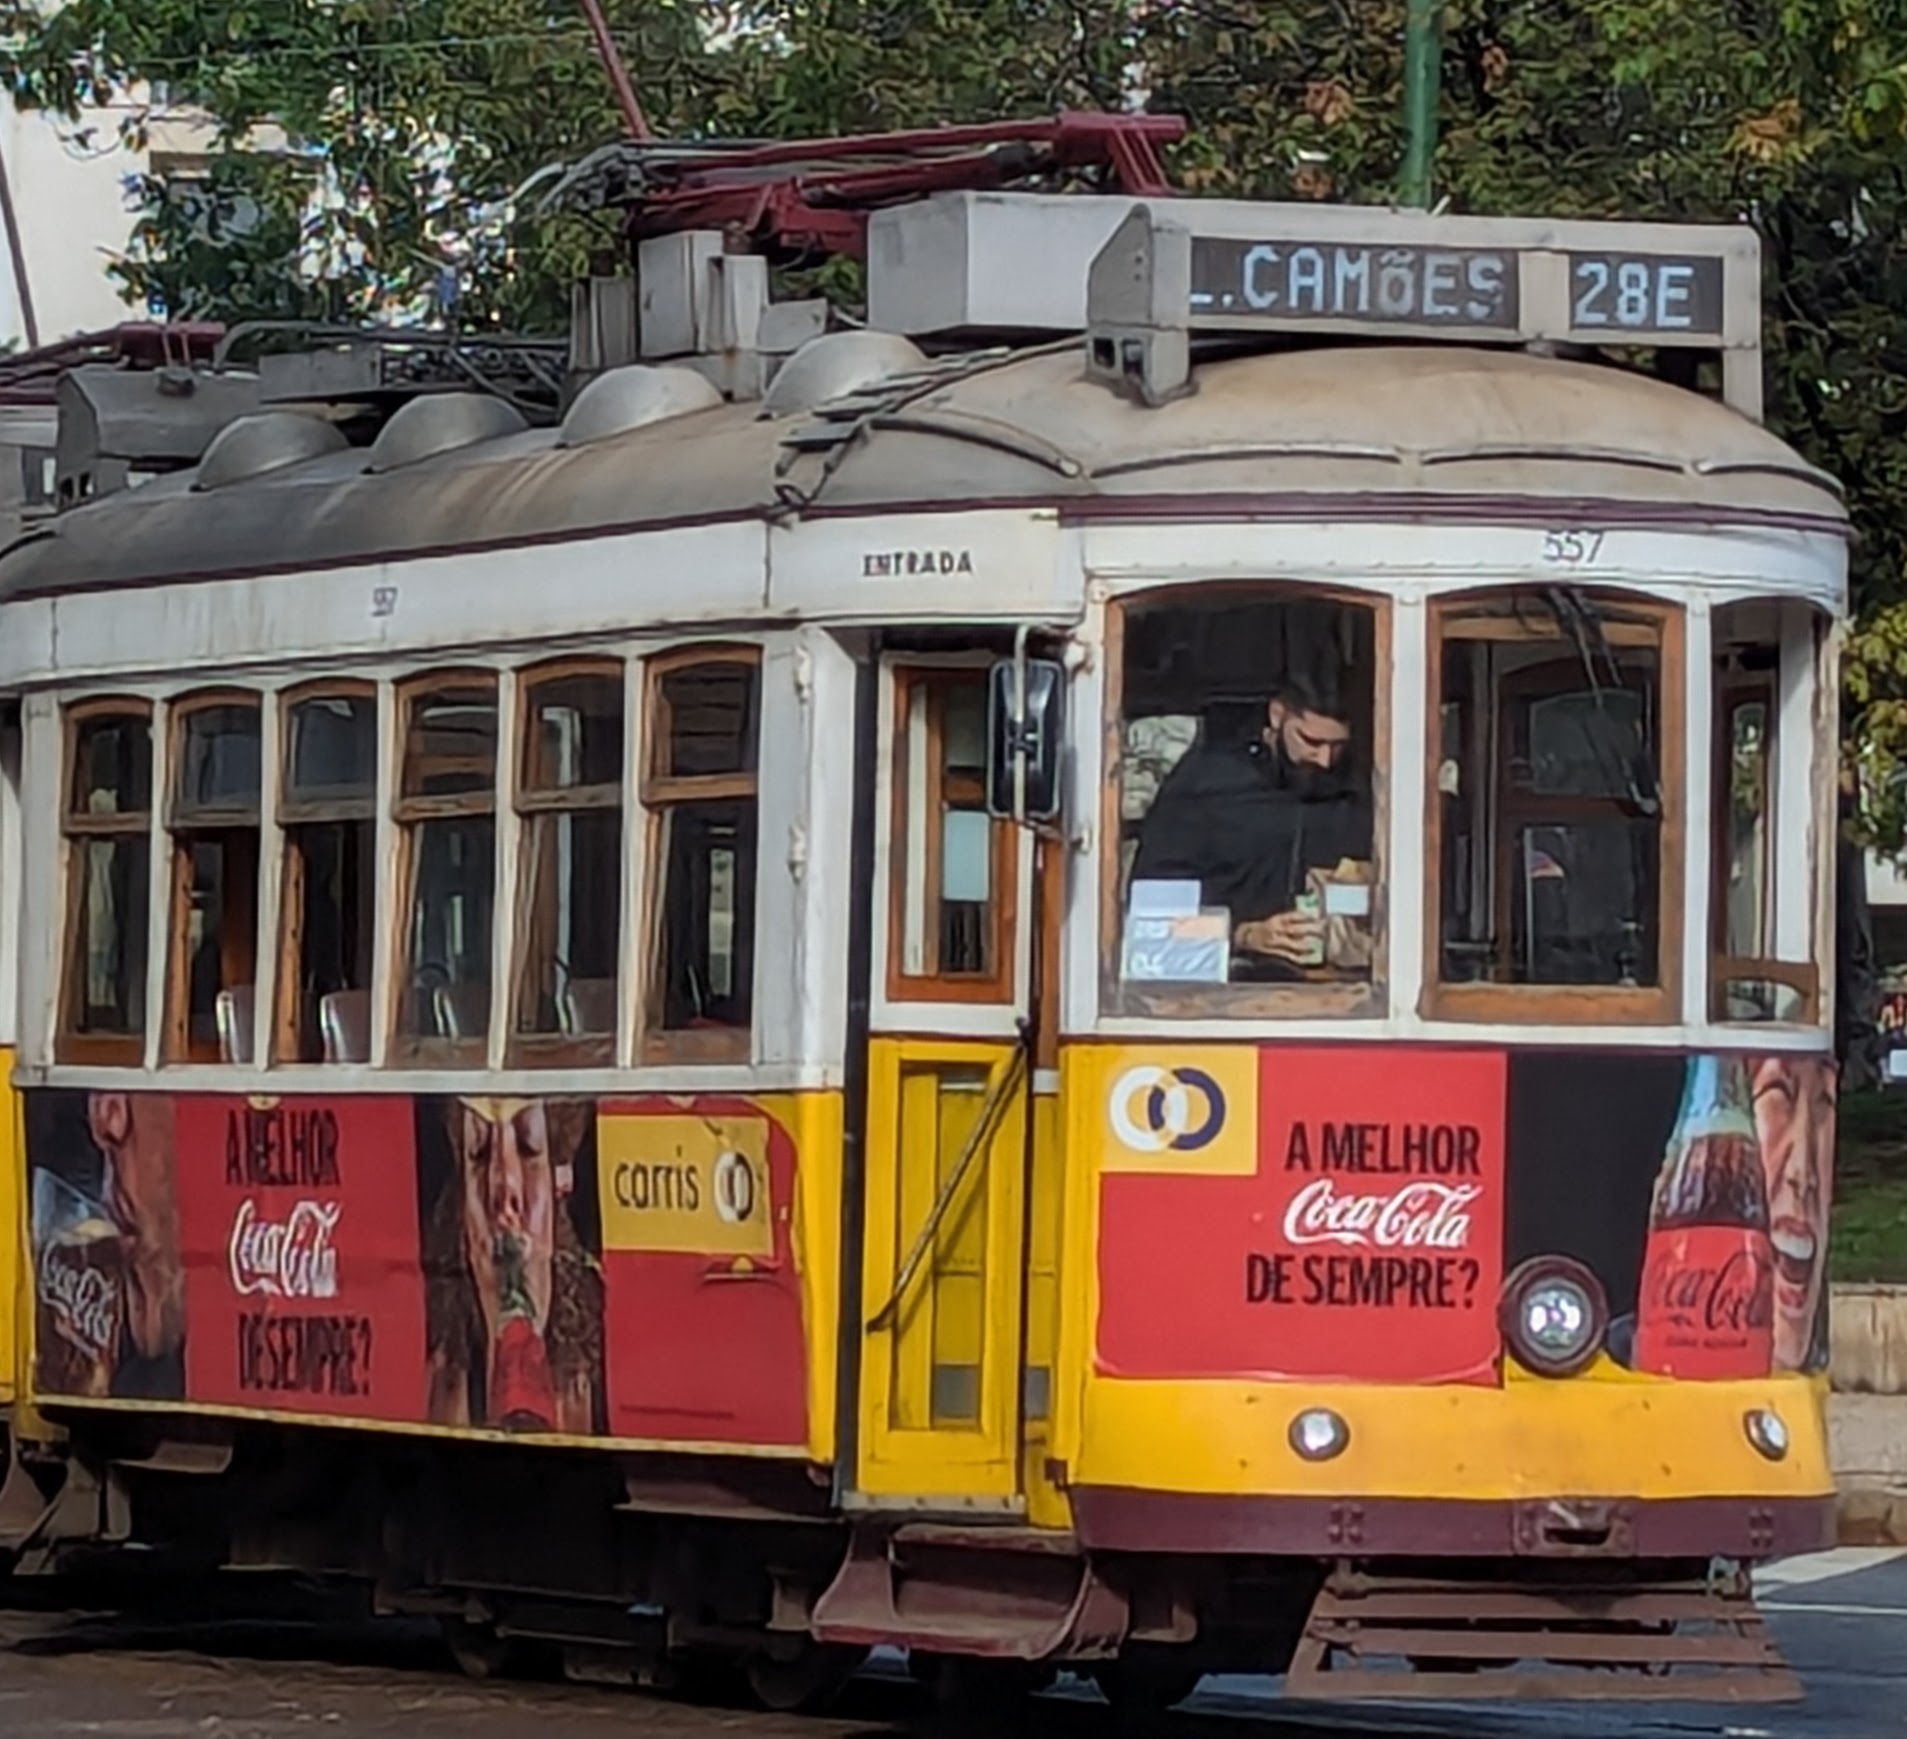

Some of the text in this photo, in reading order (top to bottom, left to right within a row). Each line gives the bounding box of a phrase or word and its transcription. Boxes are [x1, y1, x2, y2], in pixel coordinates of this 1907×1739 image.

[1574, 261, 1694, 327] 28E
[863, 551, 972, 577] ENTRADA
[1541, 529, 1605, 563] 557
[226, 1109, 243, 1186] A
[1284, 1120, 1481, 1176] A MELHOR
[614, 1144, 700, 1212] carris
[1246, 1253, 1480, 1310] DE SEMPRE?
